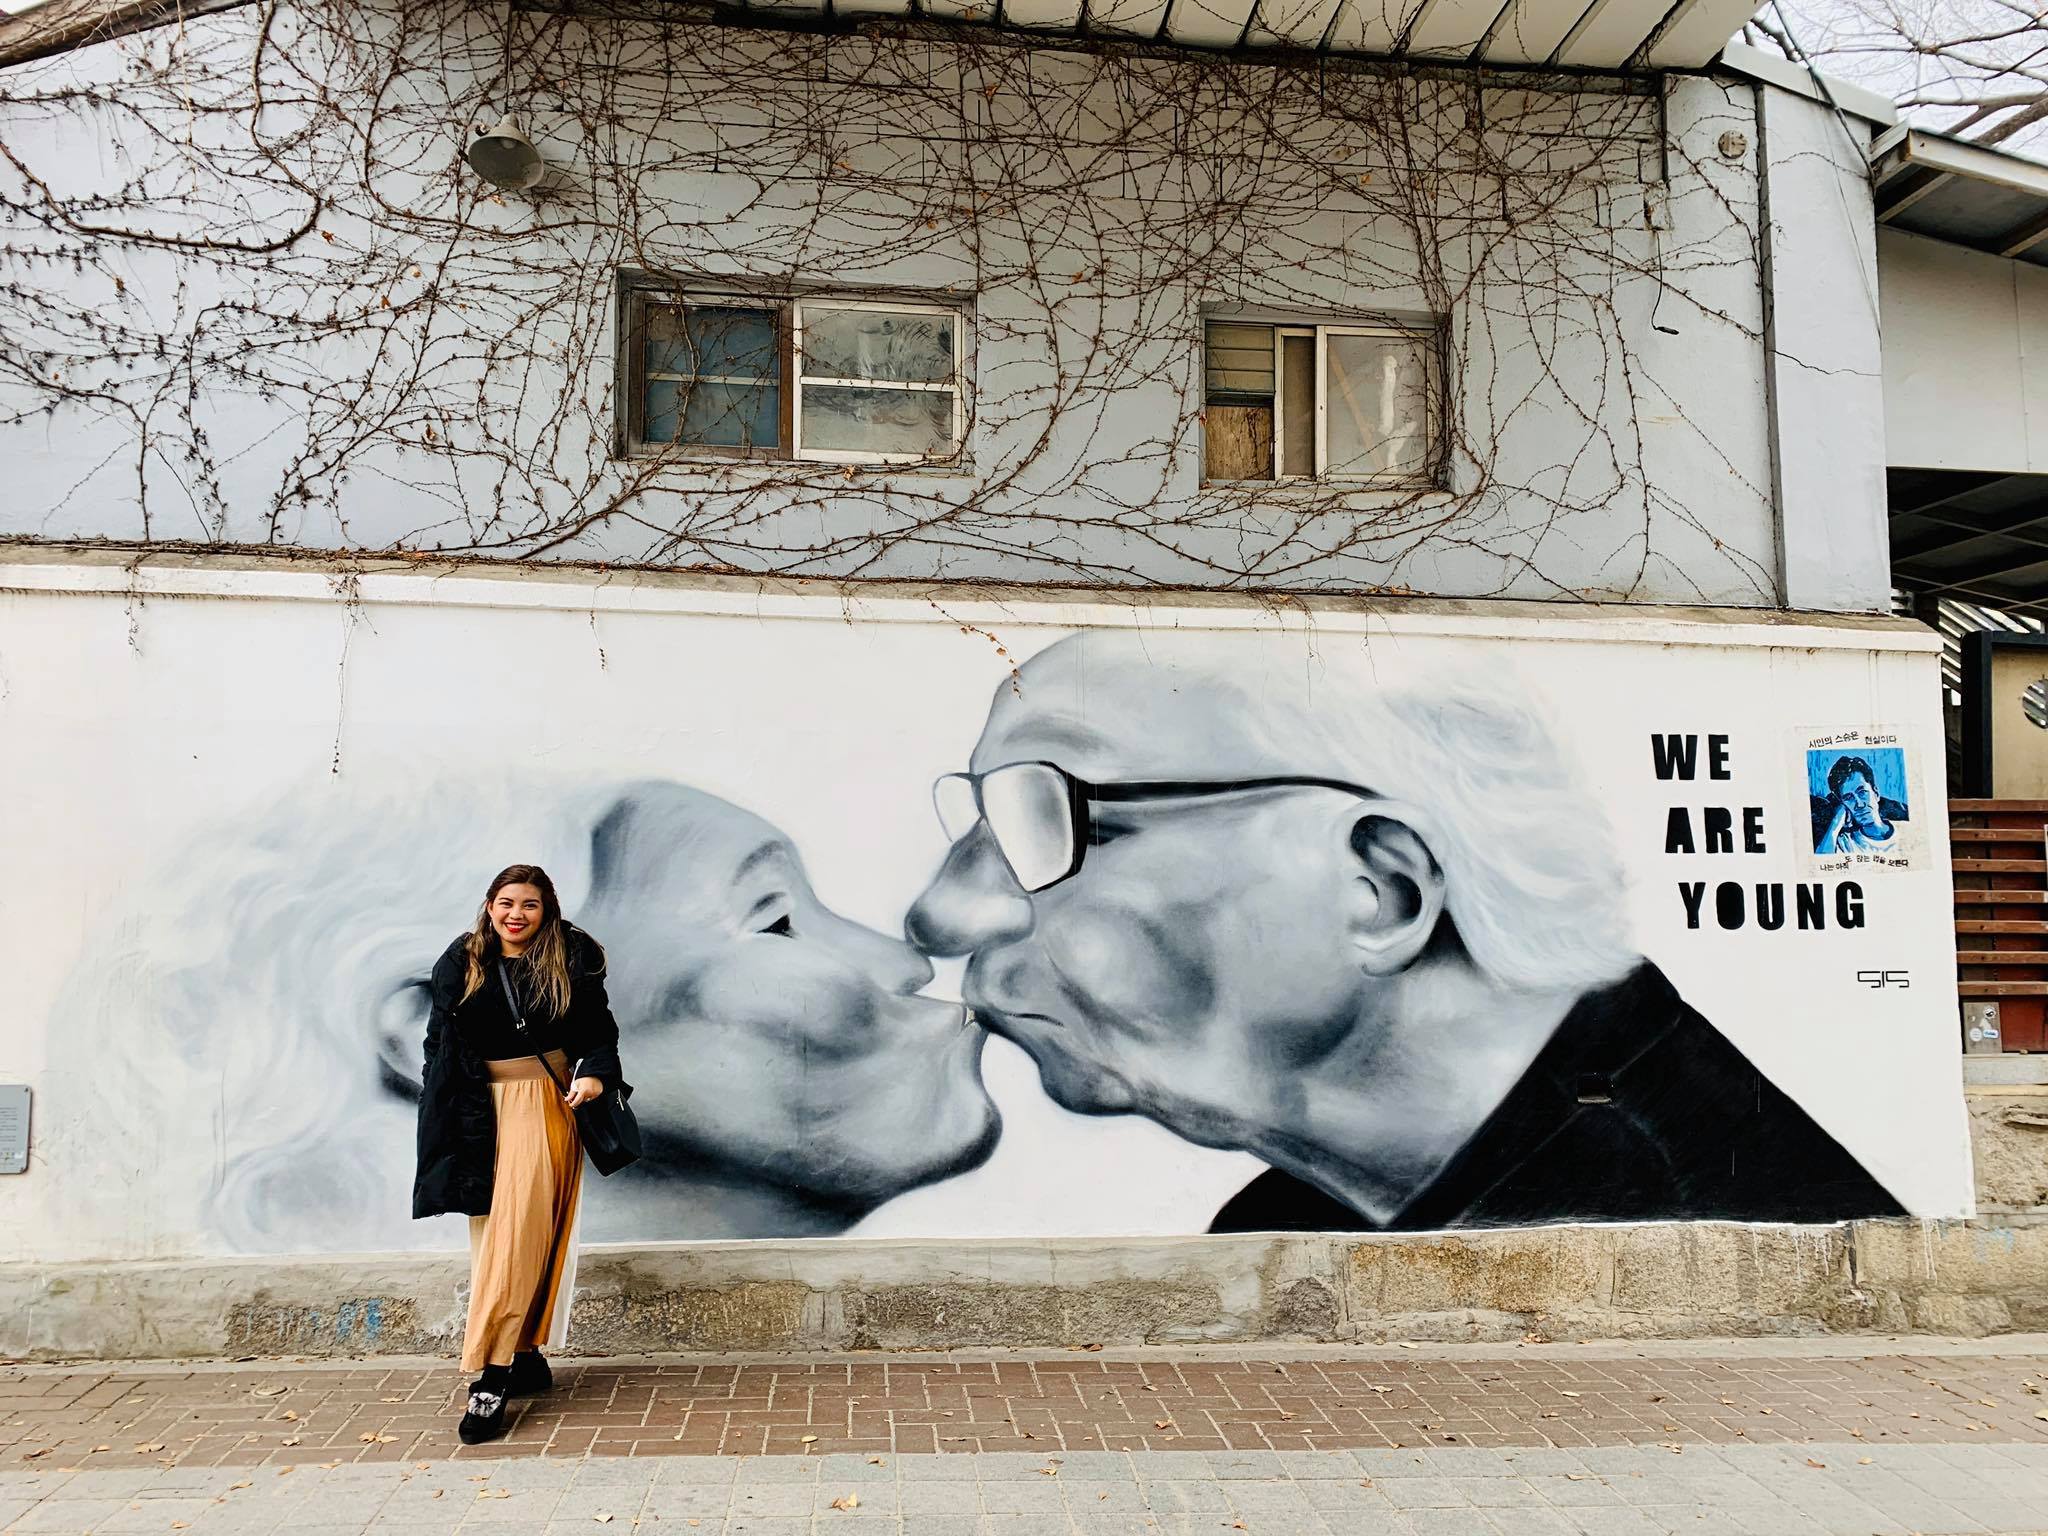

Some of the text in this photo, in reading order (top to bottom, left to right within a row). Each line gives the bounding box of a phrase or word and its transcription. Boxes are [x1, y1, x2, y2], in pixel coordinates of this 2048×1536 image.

[1651, 734, 1731, 780] WE
[1808, 735, 1833, 748] 시인의
[1864, 735, 1897, 745] 현실이다
[1665, 807, 1766, 853] ARE
[1678, 881, 1865, 930] YOUNG
